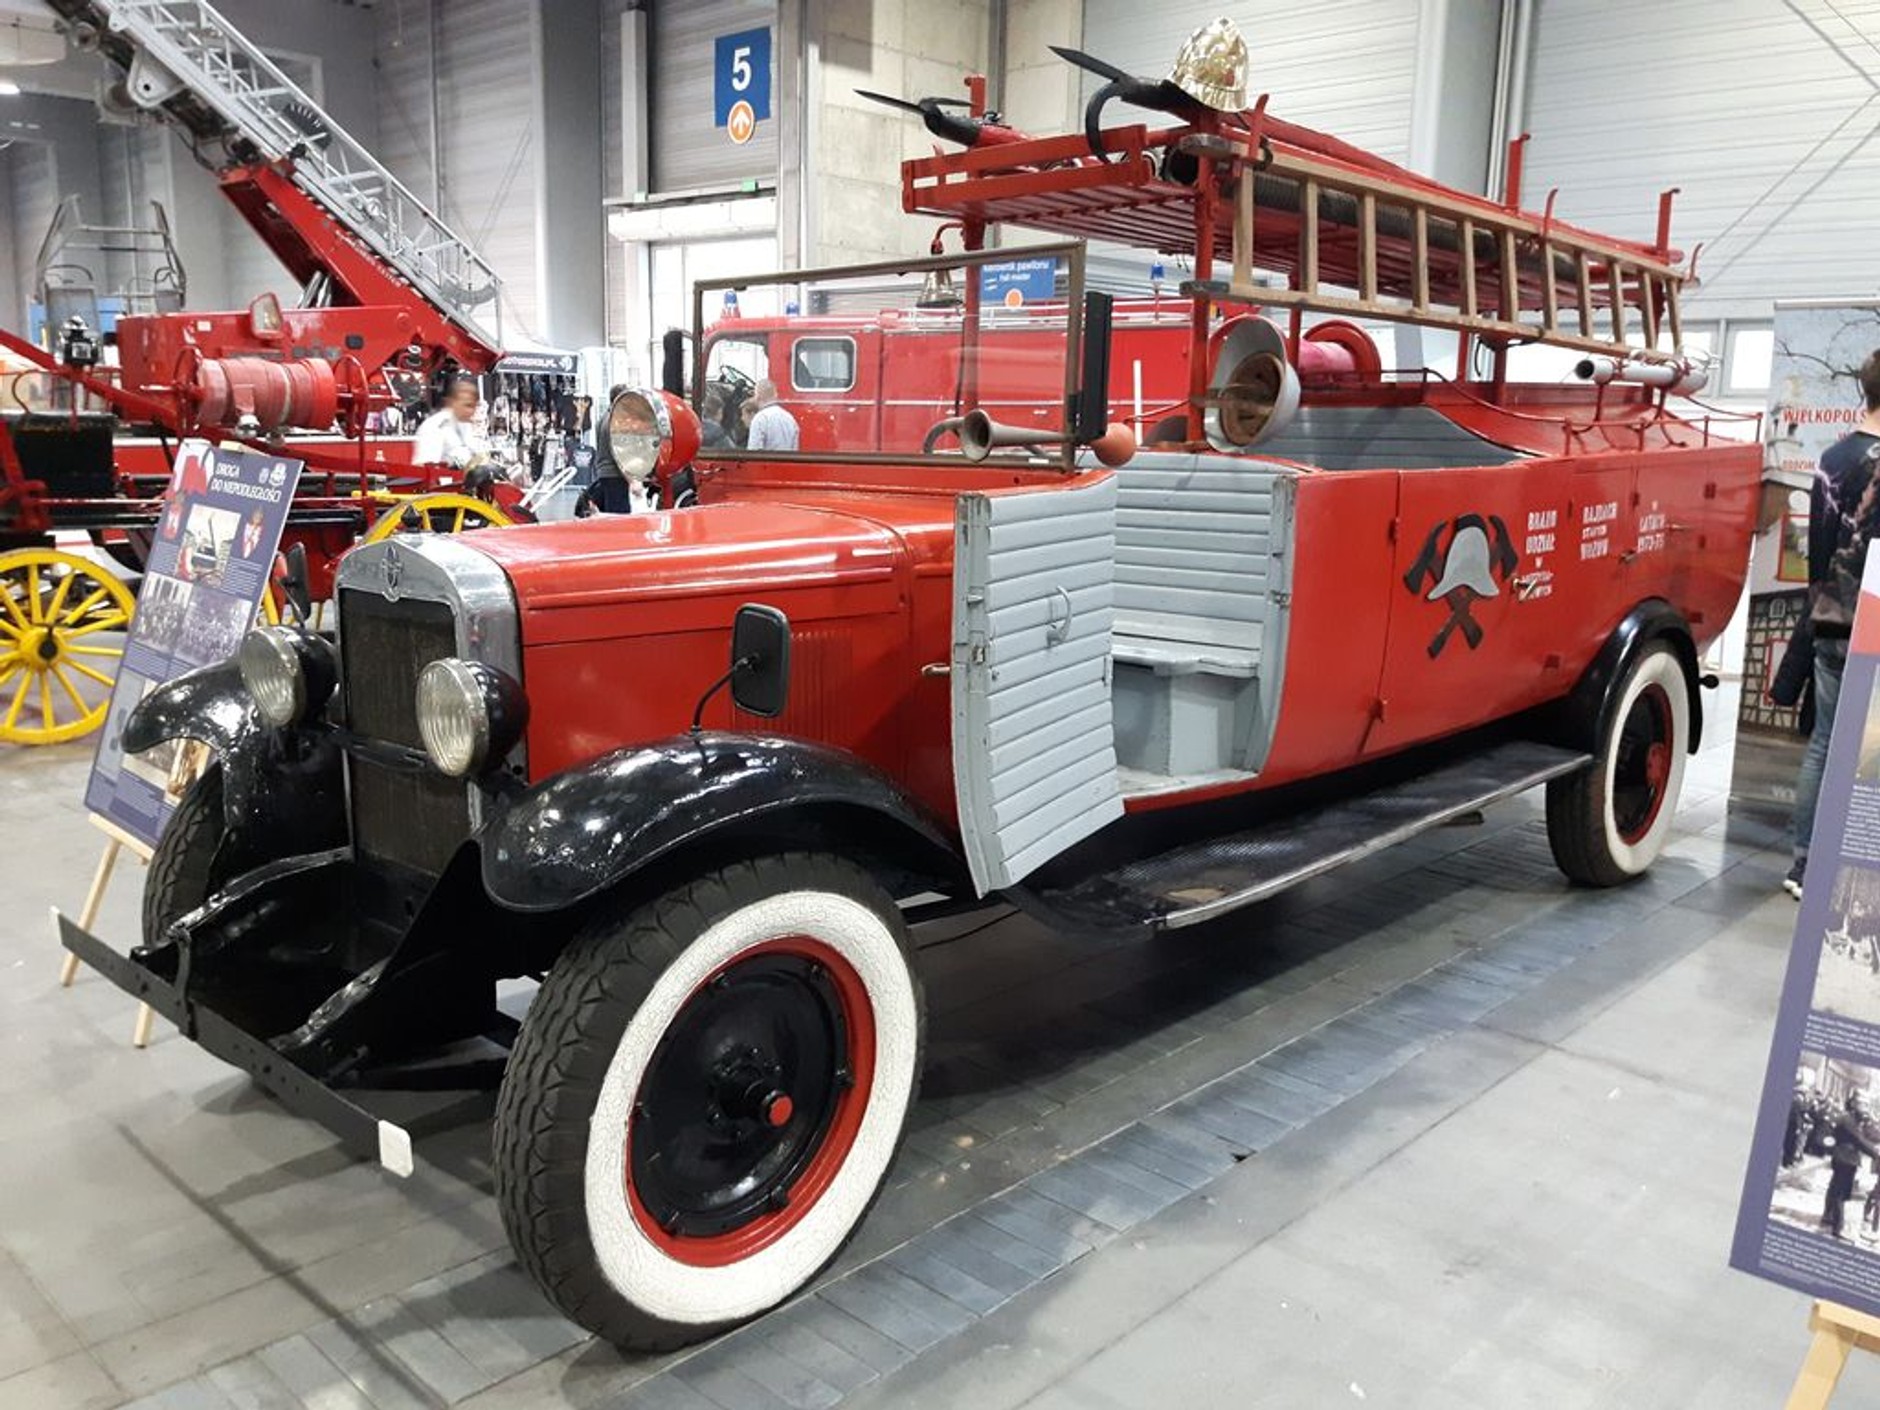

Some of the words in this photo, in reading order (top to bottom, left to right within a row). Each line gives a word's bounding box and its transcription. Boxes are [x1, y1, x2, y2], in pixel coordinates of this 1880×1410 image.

[731, 46, 752, 91] 5
[215, 462, 240, 478] DROGA
[210, 477, 223, 492] DO
[223, 480, 282, 503] NIEPODLEGŁOŚCI
